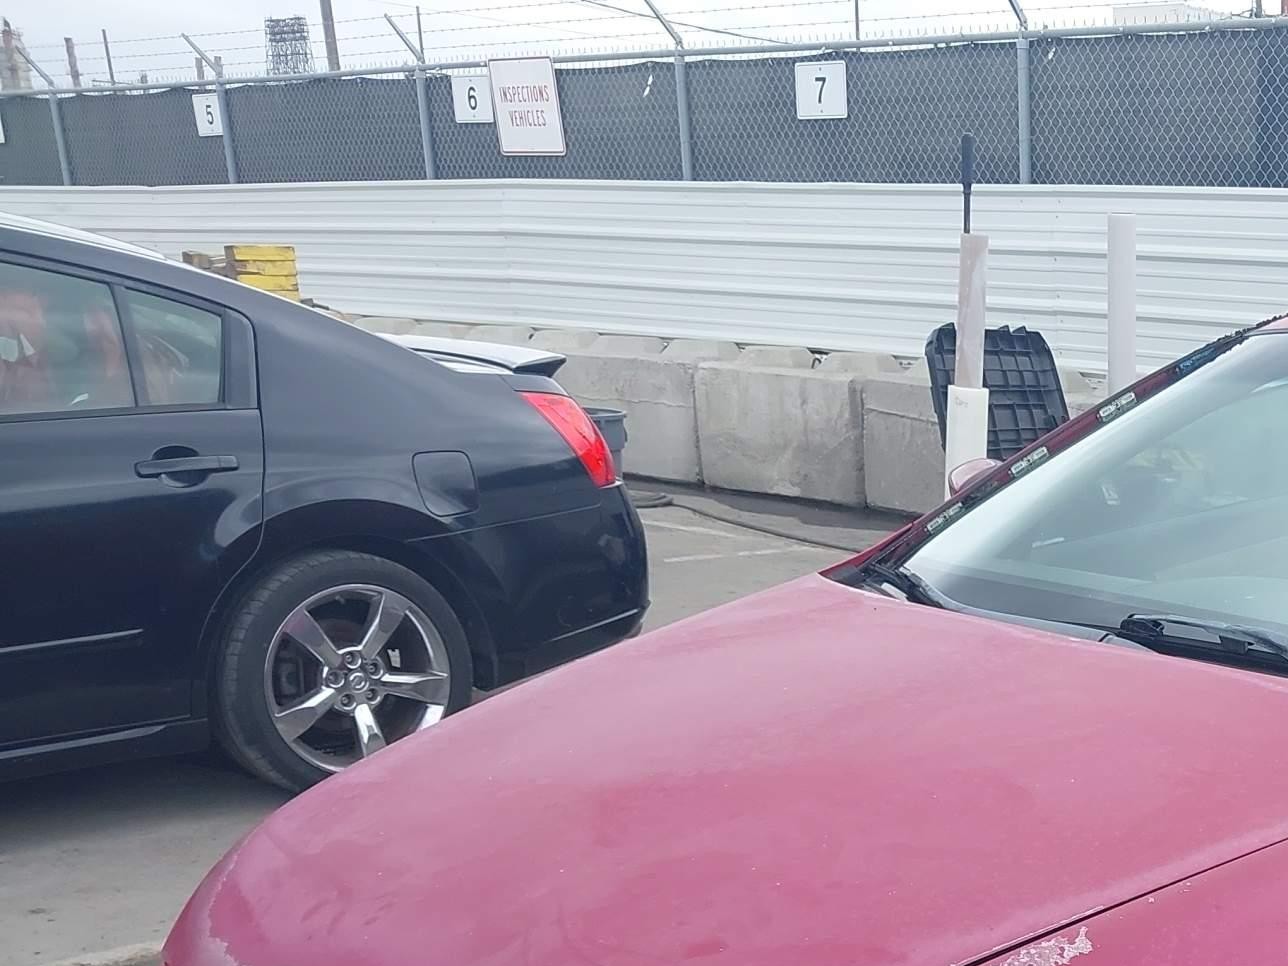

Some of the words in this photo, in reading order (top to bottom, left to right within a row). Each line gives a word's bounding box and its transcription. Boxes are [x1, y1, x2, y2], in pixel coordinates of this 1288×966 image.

[467, 86, 478, 111] 6
[499, 85, 550, 103] INSPECTIONS
[814, 76, 827, 105] 7
[205, 104, 214, 125] 5
[509, 110, 547, 127] VEHICLES
